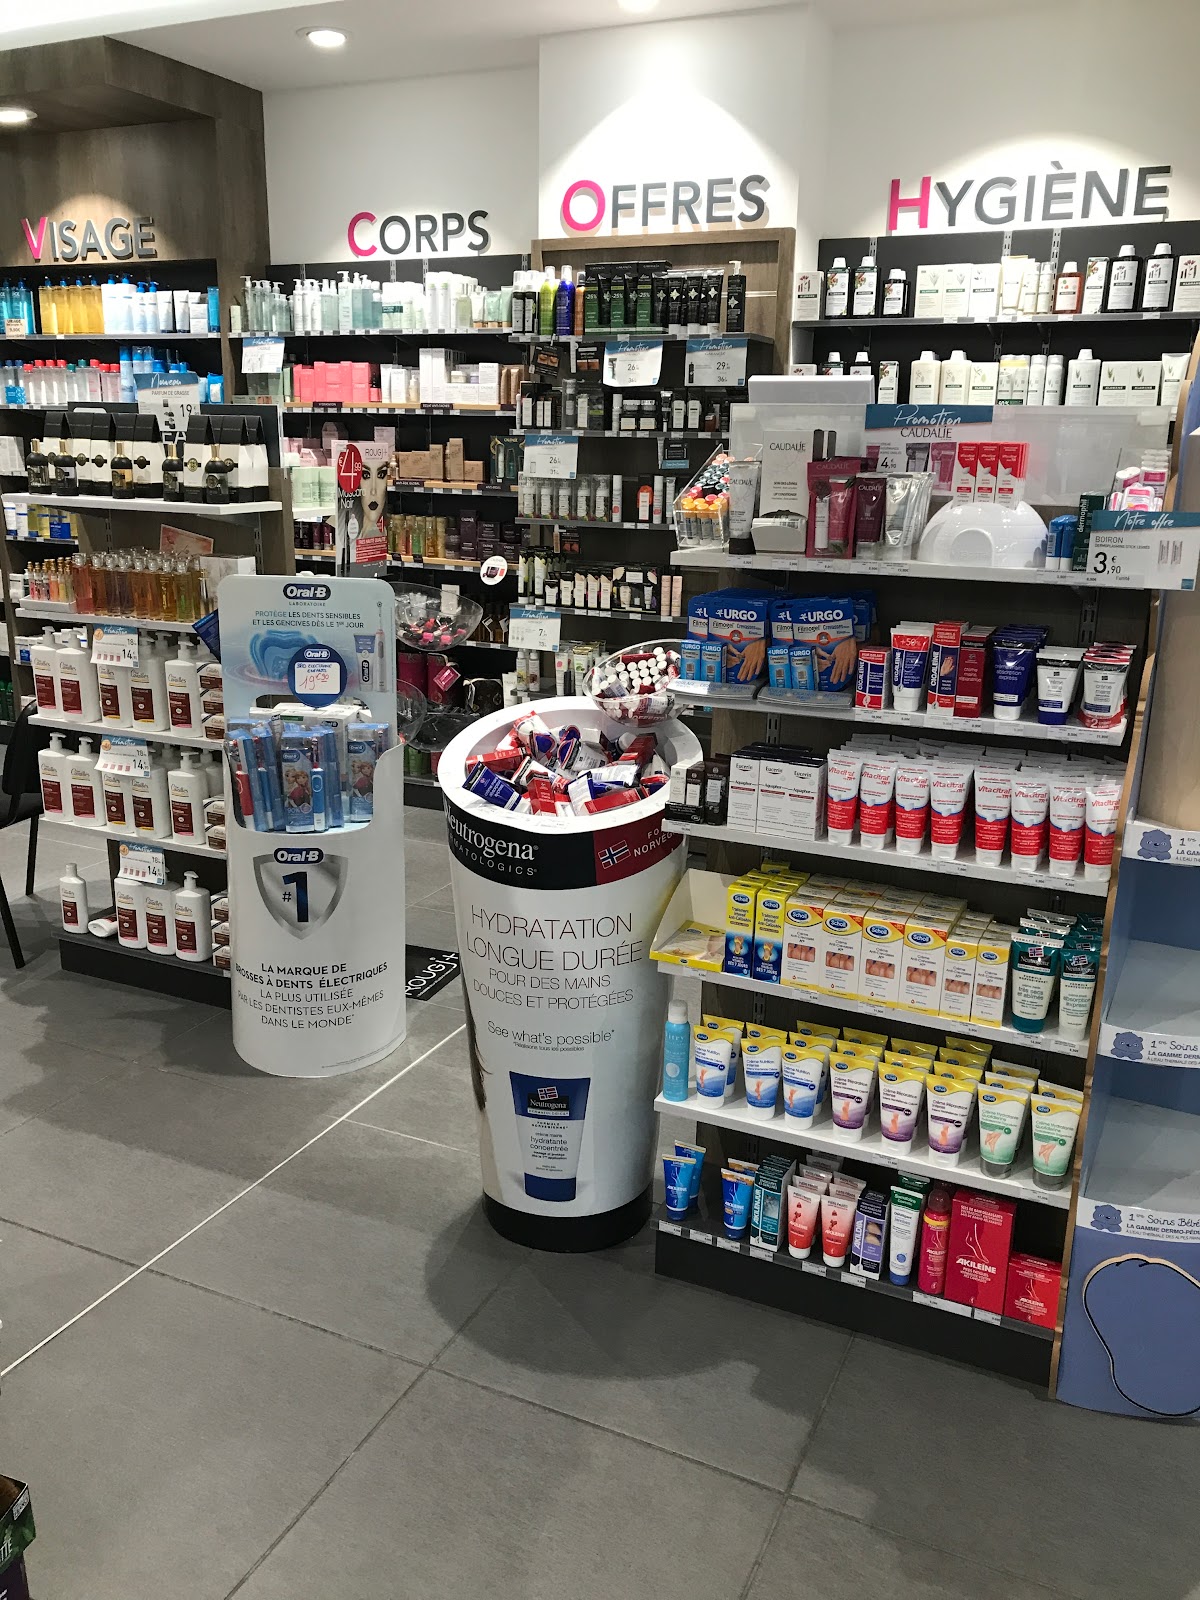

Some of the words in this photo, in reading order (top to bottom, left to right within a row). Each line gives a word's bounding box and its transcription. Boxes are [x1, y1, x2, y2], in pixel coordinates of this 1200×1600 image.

[888, 161, 1172, 231] HYGIÈNE
[561, 174, 771, 232] OFFRES
[20, 215, 157, 261] VISAGE
[347, 209, 490, 257] CORPS
[699, 338, 733, 351] Promotion
[894, 404, 962, 427] Promotion
[340, 448, 358, 489] 4
[880, 456, 888, 468] 4
[340, 498, 354, 509] Noir
[1078, 496, 1090, 533] dermophil
[1114, 512, 1147, 531] Notre
[1151, 513, 1175, 531] offre
[1095, 536, 1124, 544] BOIRON
[1093, 552, 1108, 574] 3
[286, 586, 327, 598] Oral-B
[256, 610, 287, 618] PROTÈGE
[724, 608, 758, 621] URGO
[806, 609, 844, 622] URGO
[122, 648, 133, 660] 14
[305, 650, 328, 658] Oral-B
[132, 758, 143, 770] 14
[794, 770, 812, 778] Eucerin
[276, 851, 320, 862] Oral-B
[792, 911, 808, 919] Scholl
[472, 904, 632, 940] HYDRATATION
[830, 920, 848, 928] Scholl
[872, 926, 890, 934] Scholl
[912, 934, 931, 943] Scholl
[466, 931, 555, 971] LONGUE
[562, 940, 644, 971] DURÉE
[261, 962, 274, 973] LA
[276, 964, 330, 976] MARQUE
[332, 962, 348, 973] DE
[266, 975, 274, 987] À
[276, 978, 314, 990] DENTS
[319, 962, 388, 988] ÉLECTRIQUES
[489, 968, 526, 988] POUR
[530, 976, 560, 990] DES
[564, 974, 611, 990] MAINS
[260, 990, 272, 999] LA
[275, 990, 302, 1002] PLUS
[304, 988, 354, 1002] UTILISÉE
[473, 978, 523, 1007] DOUCES
[526, 996, 542, 1008] ET
[548, 988, 634, 1010] PROTÉGÉES
[249, 1000, 264, 1011] LES
[265, 1002, 324, 1016] DENTISTES
[326, 990, 384, 1014] EUX-MÊMES
[261, 1015, 289, 1029] DANS
[292, 1020, 305, 1029] LE
[487, 1020, 509, 1038] See
[512, 1030, 552, 1044] what's
[1170, 1040, 1198, 1052] Soins
[530, 1098, 567, 1110] Neutrogena
[530, 1136, 568, 1146] hydratante
[530, 1144, 568, 1152] concentrée
[1147, 1214, 1176, 1226] Soins
